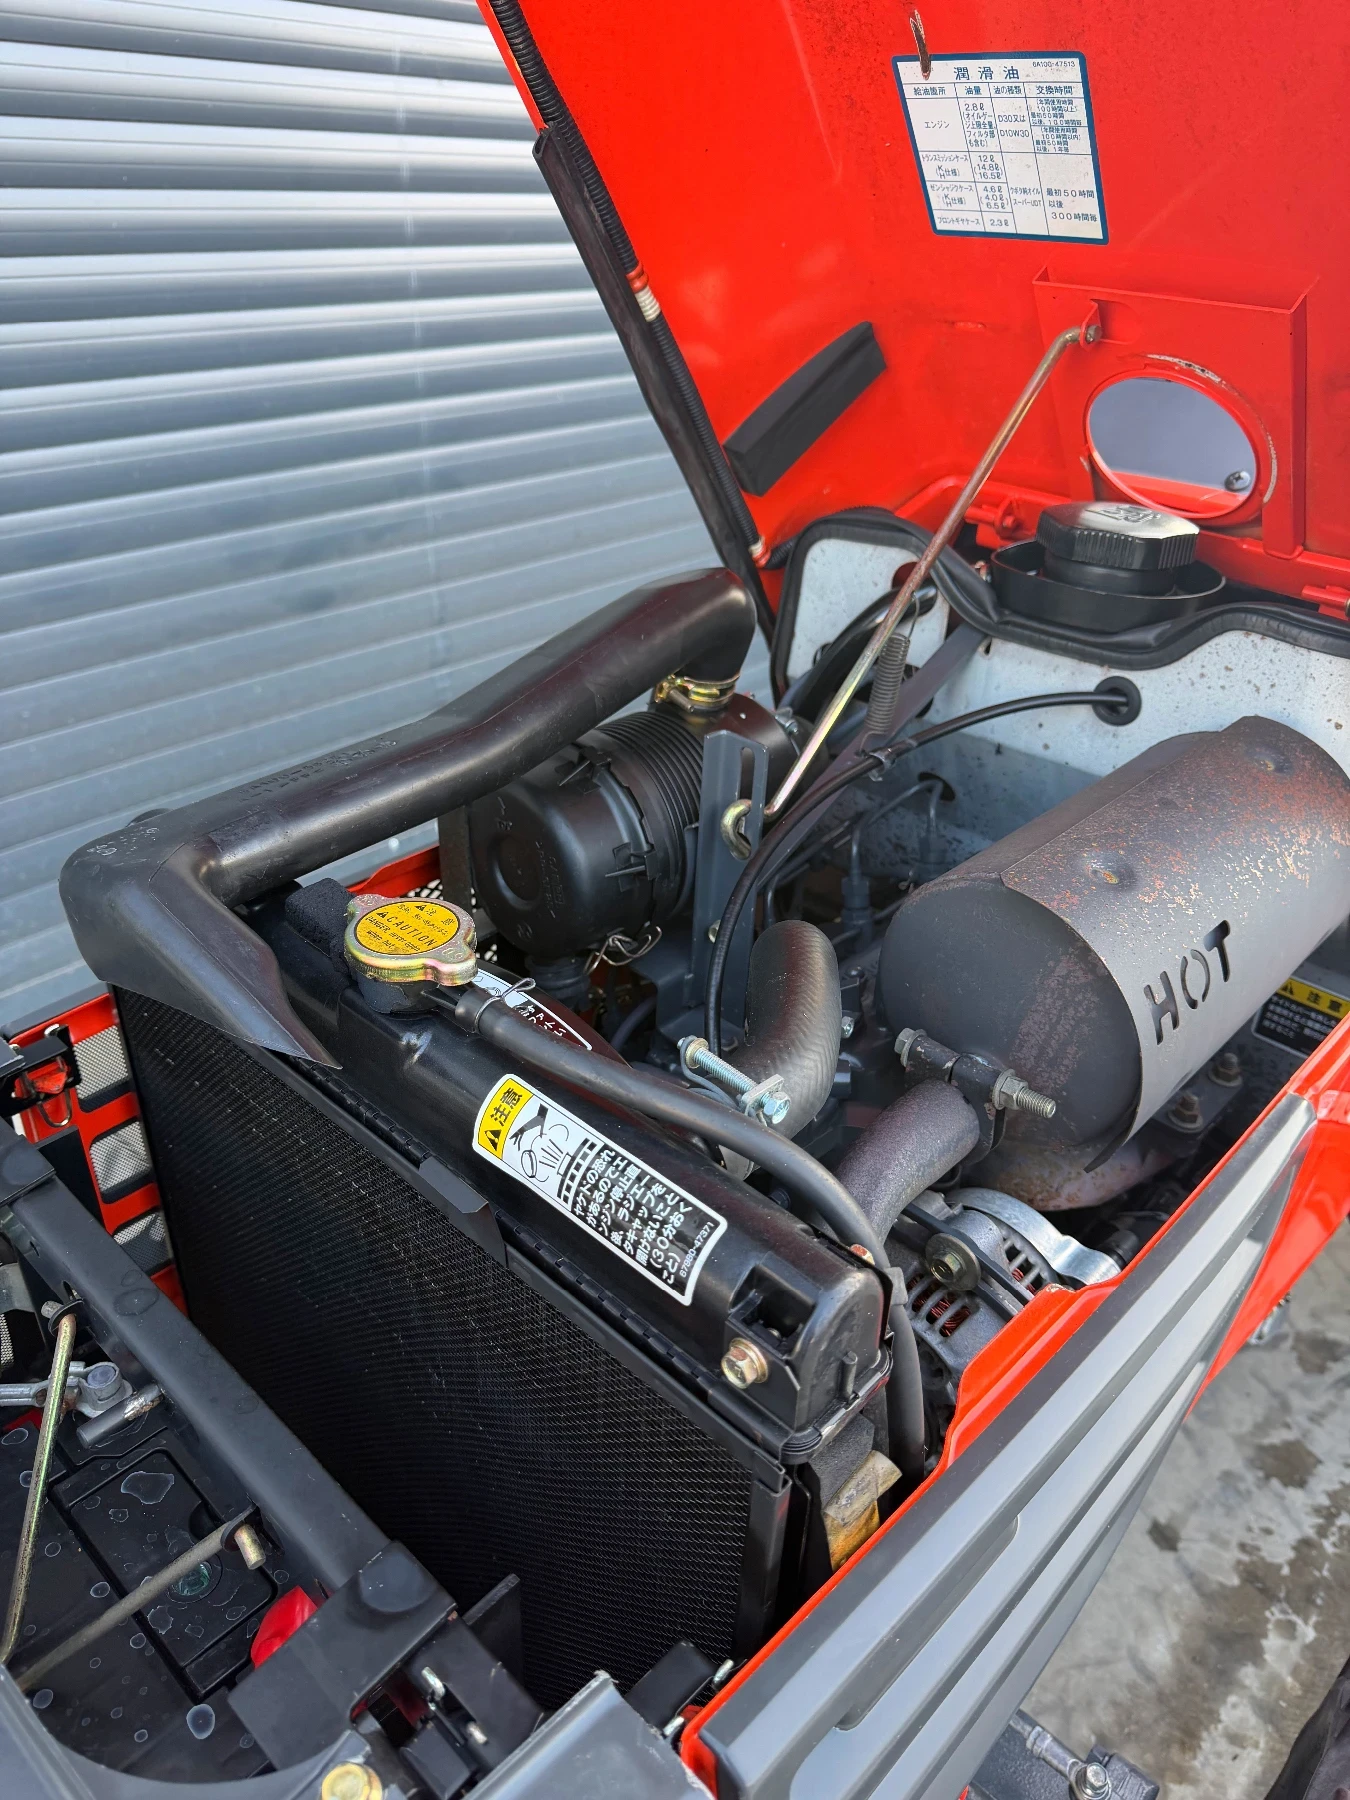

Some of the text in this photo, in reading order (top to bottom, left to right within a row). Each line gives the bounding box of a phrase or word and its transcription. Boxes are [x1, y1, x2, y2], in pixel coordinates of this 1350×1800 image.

[955, 66, 1020, 81] 潤滑油
[913, 87, 946, 95] 給油箇所
[965, 86, 982, 95] 油量
[994, 86, 1022, 95] 油の種類
[1036, 86, 1073, 95] 交換時間
[924, 121, 949, 129] エンジン
[998, 115, 1026, 123] D30又は
[1000, 129, 1030, 138] D10W30
[1052, 212, 1098, 222] 300時間毎
[386, 916, 438, 947] CAUTION
[1143, 919, 1230, 1046] HOT
[490, 1087, 523, 1127] 注意
[574, 1150, 615, 1216] ヤケドの恐れ
[586, 1157, 628, 1227] があるのでエ
[599, 1164, 641, 1236] ンジン停止直
[624, 1183, 666, 1255] タキャップを
[636, 1193, 679, 1266] 開けないこと
